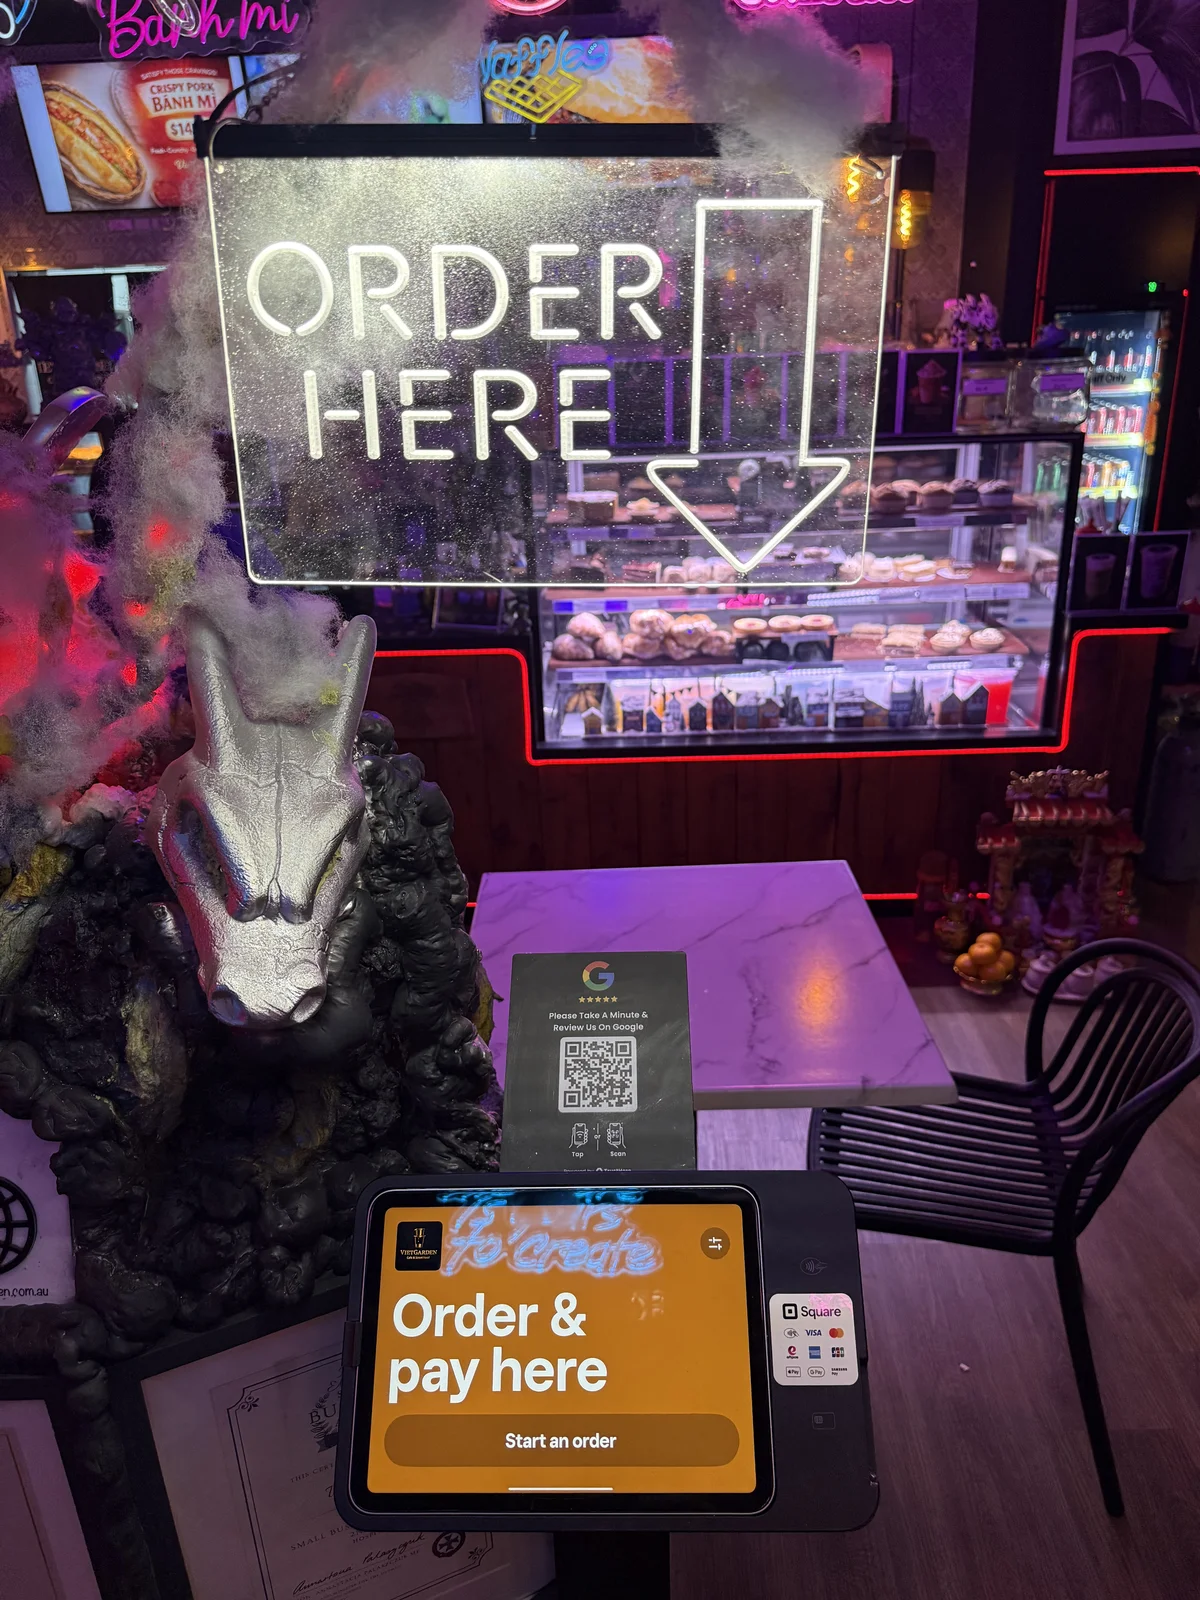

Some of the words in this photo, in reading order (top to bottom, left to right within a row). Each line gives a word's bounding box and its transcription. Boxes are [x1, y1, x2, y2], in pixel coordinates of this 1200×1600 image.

[150, 84, 185, 95] CRISPY
[187, 82, 215, 92] PORK
[152, 94, 193, 113] BÁNH
[246, 240, 664, 341] ORDER
[303, 368, 613, 461] HERE
[549, 1011, 578, 1020] Please
[579, 1011, 600, 1020] Take
[601, 1011, 609, 1019] A
[610, 1010, 640, 1019] Minute
[641, 1010, 649, 1019] &
[553, 1023, 584, 1032] Review
[585, 1023, 597, 1032] Us
[598, 1023, 611, 1032] On
[612, 1022, 644, 1033] Google
[571, 1151, 585, 1159] Tap
[393, 1293, 539, 1338] Order
[551, 1291, 587, 1337] &
[801, 1306, 841, 1319] Square
[388, 1357, 481, 1404] pay
[492, 1346, 608, 1392] here
[505, 1432, 547, 1449] Start
[549, 1436, 569, 1449] an
[572, 1432, 617, 1449] order
[290, 1534, 326, 1551] SMALL
